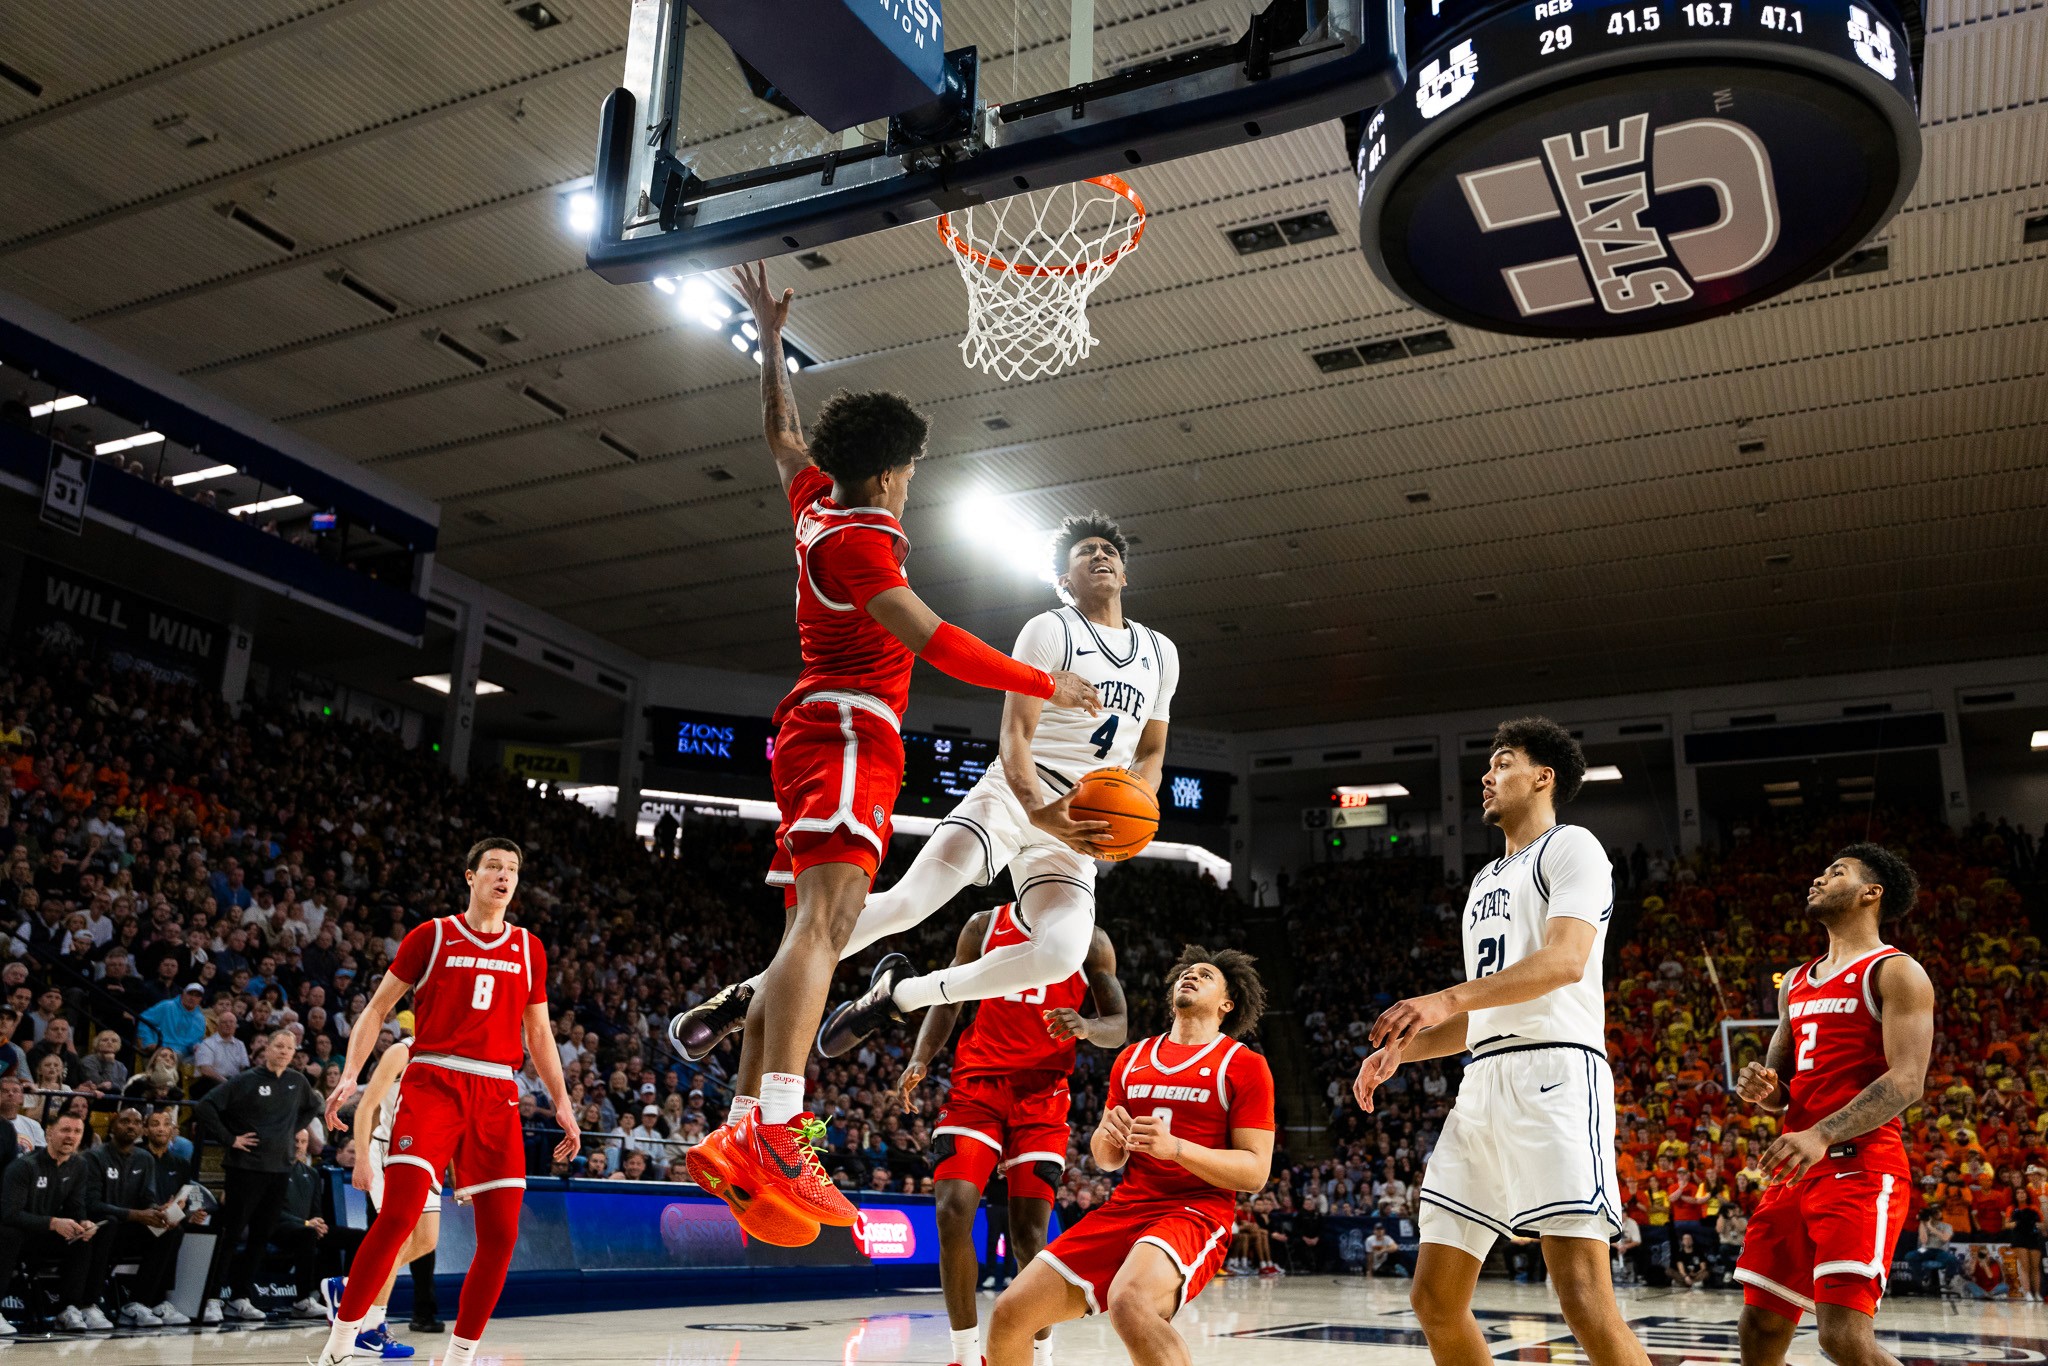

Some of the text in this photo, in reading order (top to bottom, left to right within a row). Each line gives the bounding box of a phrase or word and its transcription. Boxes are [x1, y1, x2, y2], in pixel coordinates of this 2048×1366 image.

[1535, 0, 1573, 20] REB
[1539, 3, 1803, 55] 29 41.5 16.7 47.1
[1415, 52, 1479, 109] STATE
[1542, 112, 1694, 313] STATE
[54, 483, 77, 505] 31
[46, 575, 214, 659] WILL WIN
[1094, 681, 1146, 724] TATE
[678, 722, 735, 742] ZIONS
[1089, 714, 1120, 760] 4
[513, 753, 569, 774] PIZZA
[678, 737, 732, 760] BANK
[1171, 785, 1202, 800] YORK
[1174, 776, 1200, 791] NEW
[1174, 795, 1200, 809] LIFE
[1469, 887, 1511, 931] STATE
[445, 955, 521, 974] NEW MEXICO
[1476, 933, 1506, 980] 21
[471, 974, 495, 1011] 8
[1801, 997, 1859, 1017] MEXICO
[1797, 1021, 1819, 1072] 2
[1127, 1084, 1211, 1104] NEW MEXICO
[853, 1211, 908, 1255] Gossner
